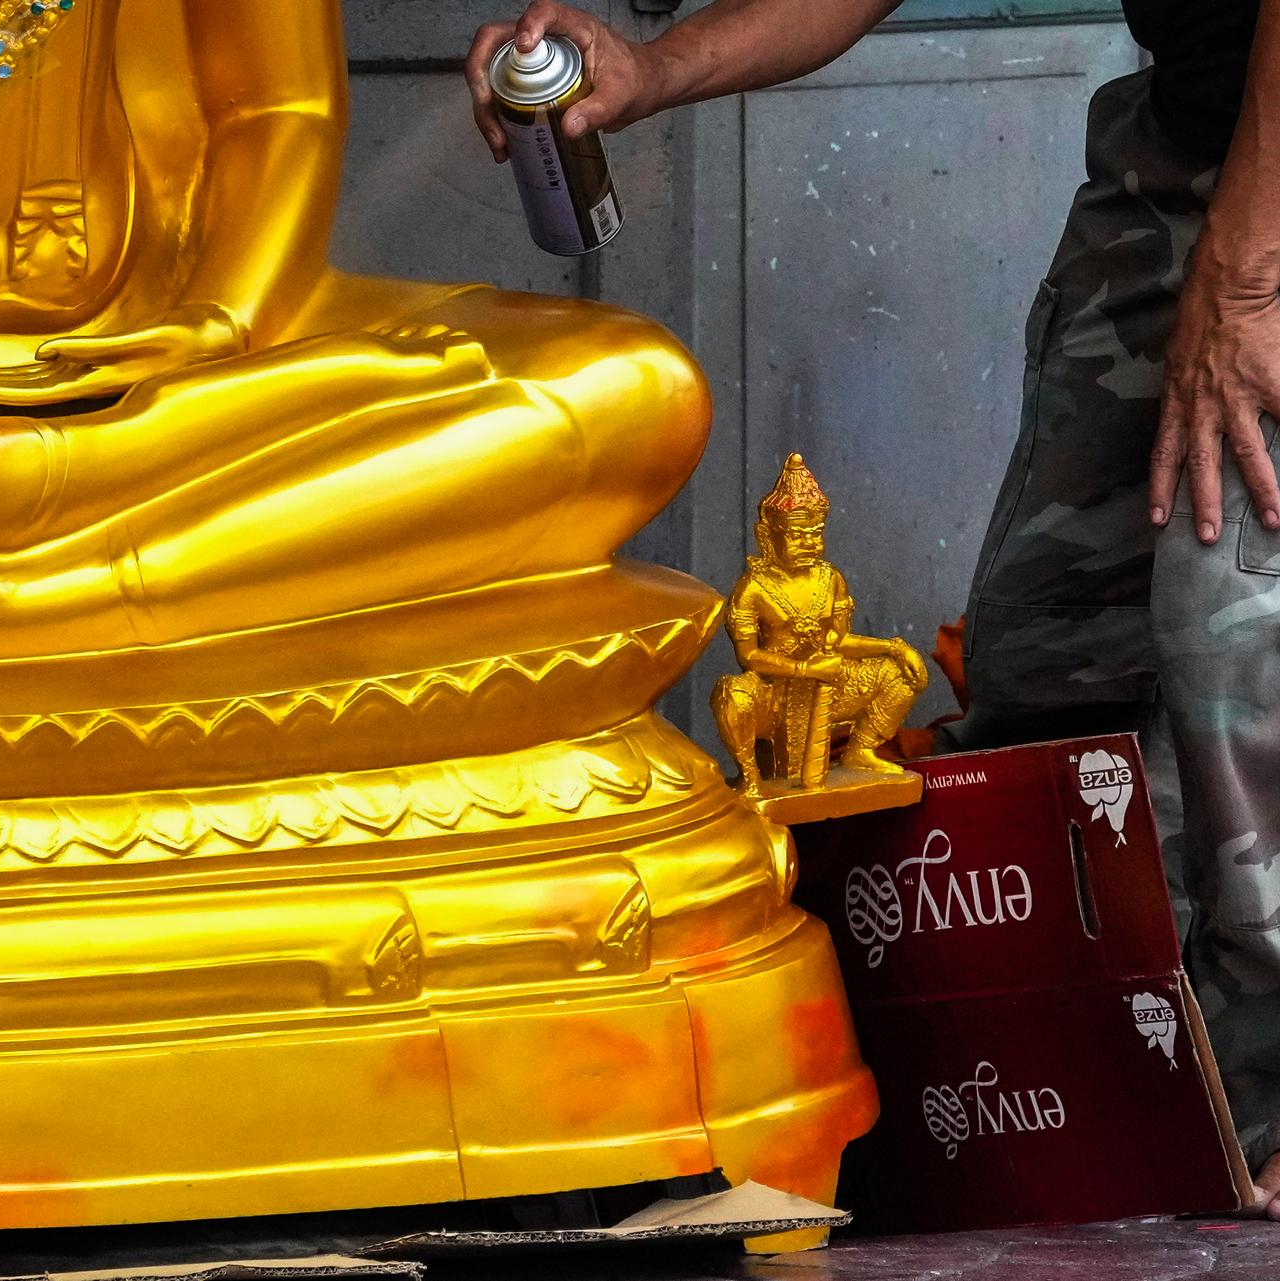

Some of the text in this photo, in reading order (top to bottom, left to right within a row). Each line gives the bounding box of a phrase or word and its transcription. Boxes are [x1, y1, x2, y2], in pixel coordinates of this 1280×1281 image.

[1078, 768, 1133, 789] enza
[895, 829, 1033, 933] envy
[1132, 1008, 1175, 1023] enza
[958, 1061, 1066, 1135] envy
